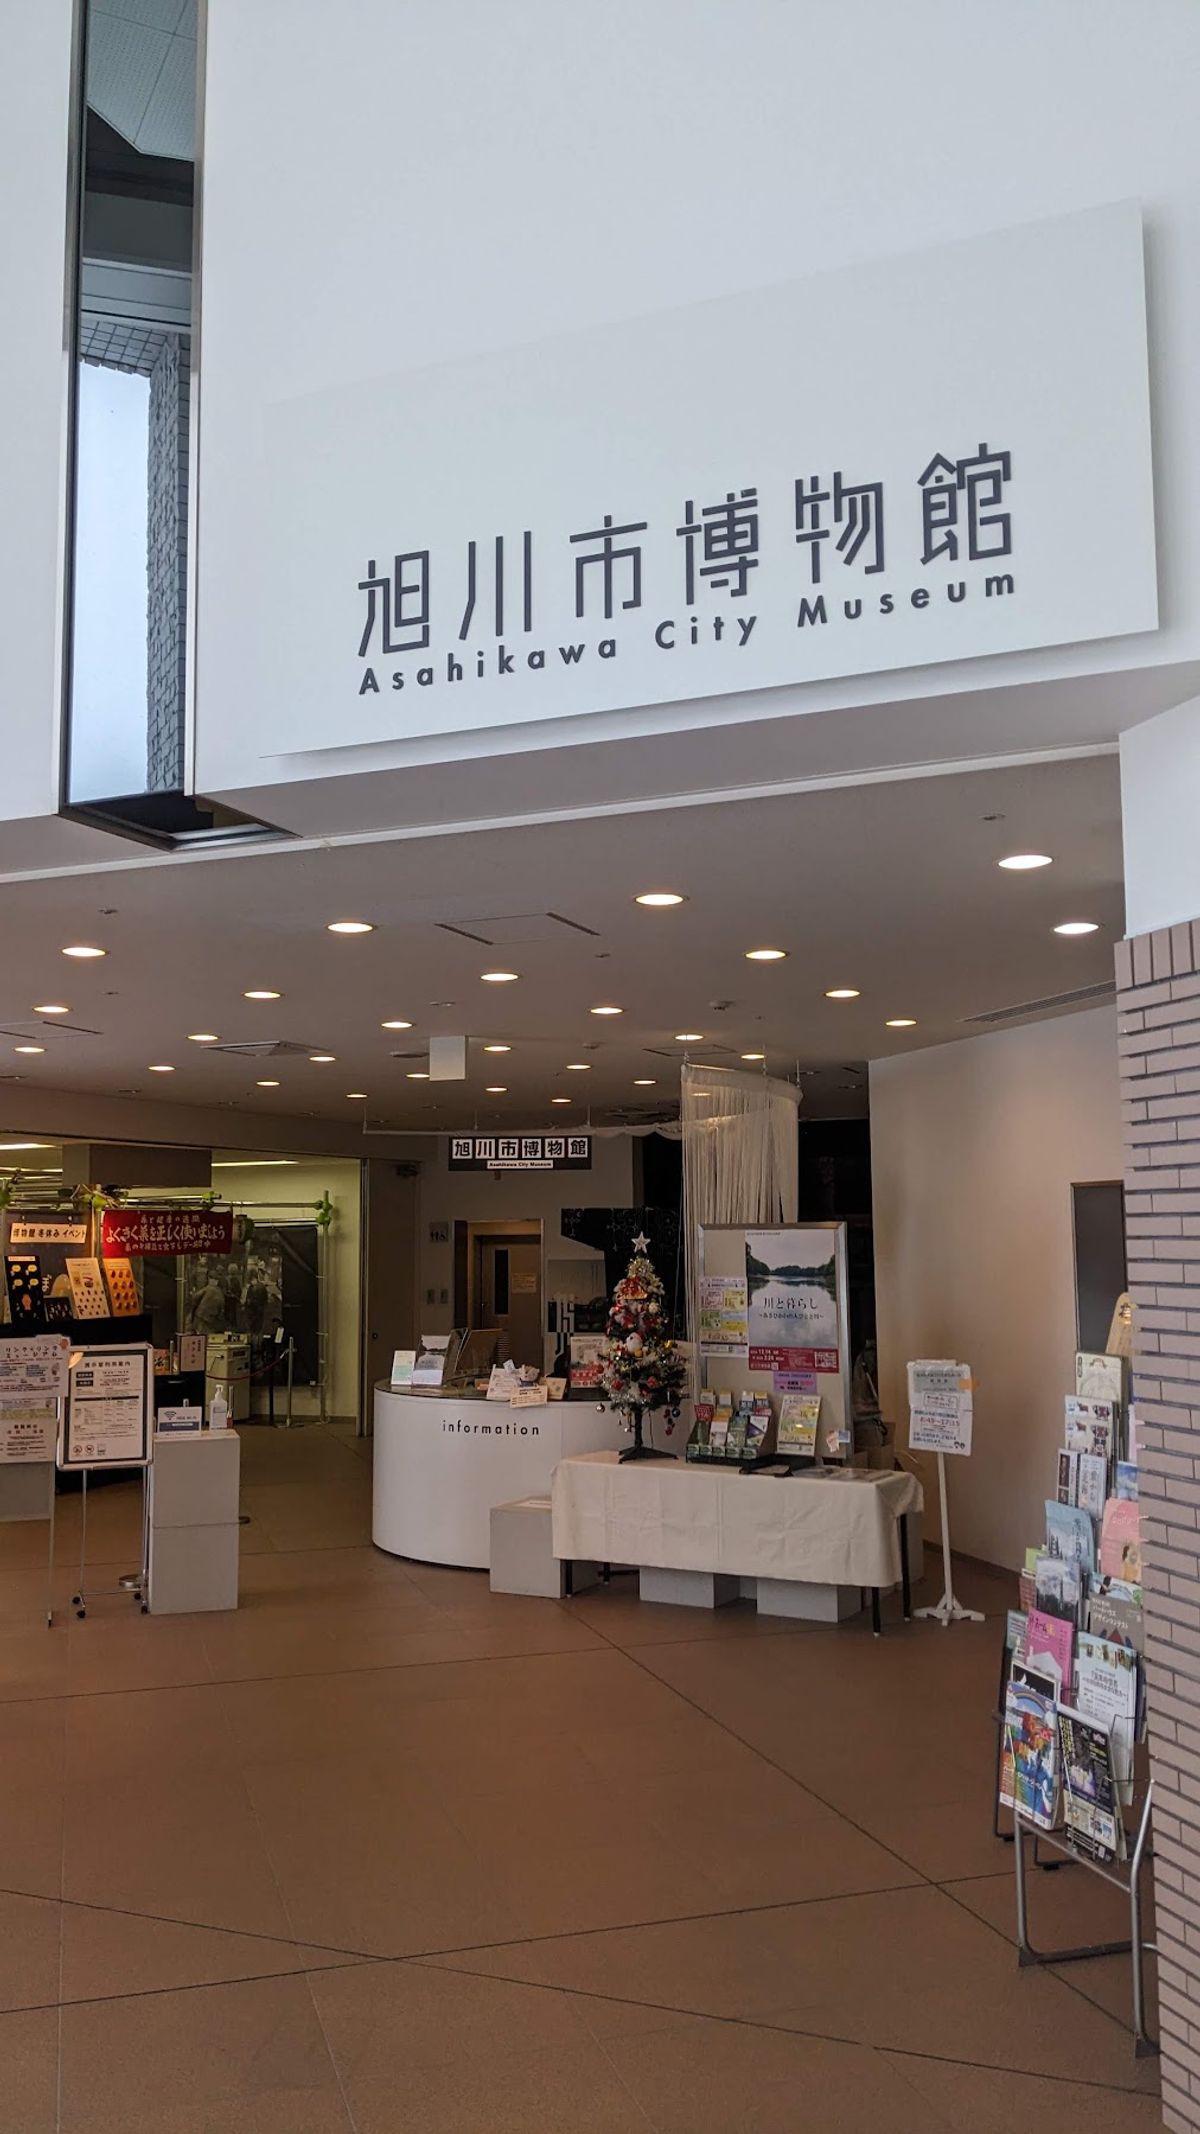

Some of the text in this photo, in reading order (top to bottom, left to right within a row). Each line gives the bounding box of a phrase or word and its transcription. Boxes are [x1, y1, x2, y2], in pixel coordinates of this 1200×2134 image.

[357, 441, 1013, 659] 旭川市博物館
[358, 573, 1015, 696] Asahikawa City Museum
[454, 1140, 586, 1157] 旭川市博物館
[764, 1297, 818, 1309] 川と暮らし
[442, 1419, 540, 1435] information
